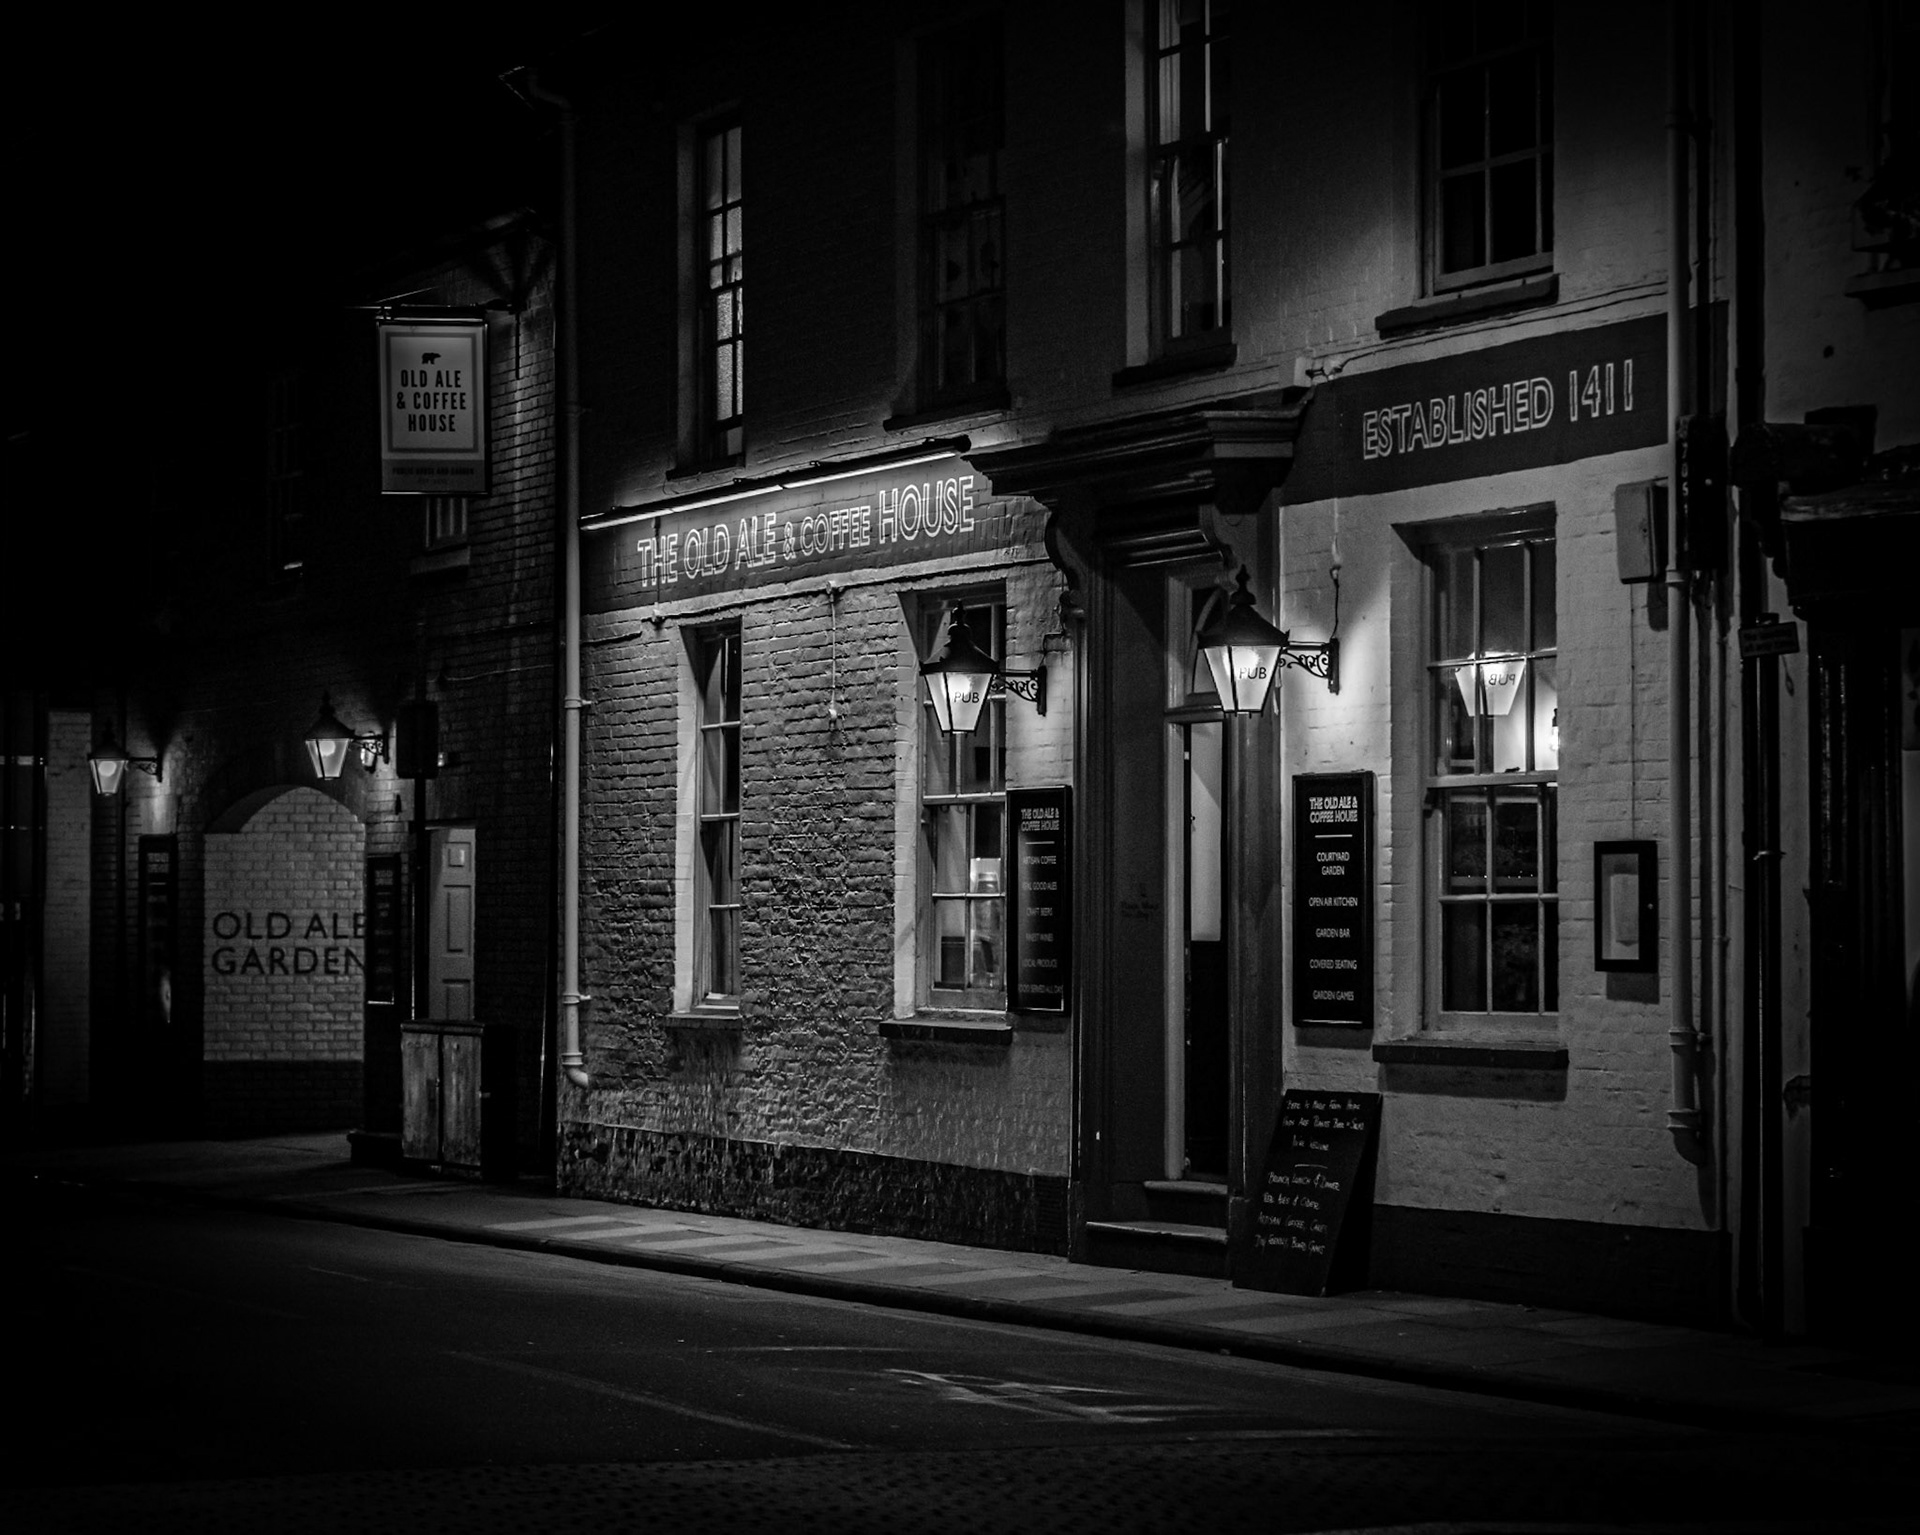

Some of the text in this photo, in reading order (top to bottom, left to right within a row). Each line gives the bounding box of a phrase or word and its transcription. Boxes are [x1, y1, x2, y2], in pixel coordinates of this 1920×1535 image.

[401, 370, 461, 387] OLD ALE
[396, 391, 466, 410] & COFFEE
[1363, 358, 1634, 460] ESTABLISHED 1411
[408, 414, 456, 432] HOUSE
[637, 474, 975, 587] THE OLD ALE & COFFEE HOUSE
[1239, 666, 1267, 680] PUB
[953, 691, 980, 704] PUB
[1309, 795, 1358, 810] THE OLD ALE &
[1021, 807, 1032, 820] THE
[1032, 807, 1044, 820] OLD
[1044, 806, 1055, 819] ALE
[1309, 809, 1358, 824] COFFEE HOUSE
[1021, 819, 1060, 832] COFFEE HOUSE
[1040, 855, 1057, 865] COFFEE
[1316, 851, 1350, 862] COURTYARD
[1321, 865, 1345, 876] GARDEN
[1308, 896, 1324, 907] OPEN
[1333, 896, 1358, 907] KITCHEN
[213, 912, 367, 940] OLD ALE
[1315, 928, 1351, 938] GARDEN BAR
[212, 946, 367, 975] GARDEN
[1335, 959, 1358, 970] SEATING
[1312, 990, 1355, 1001] GARDEN GAMES
